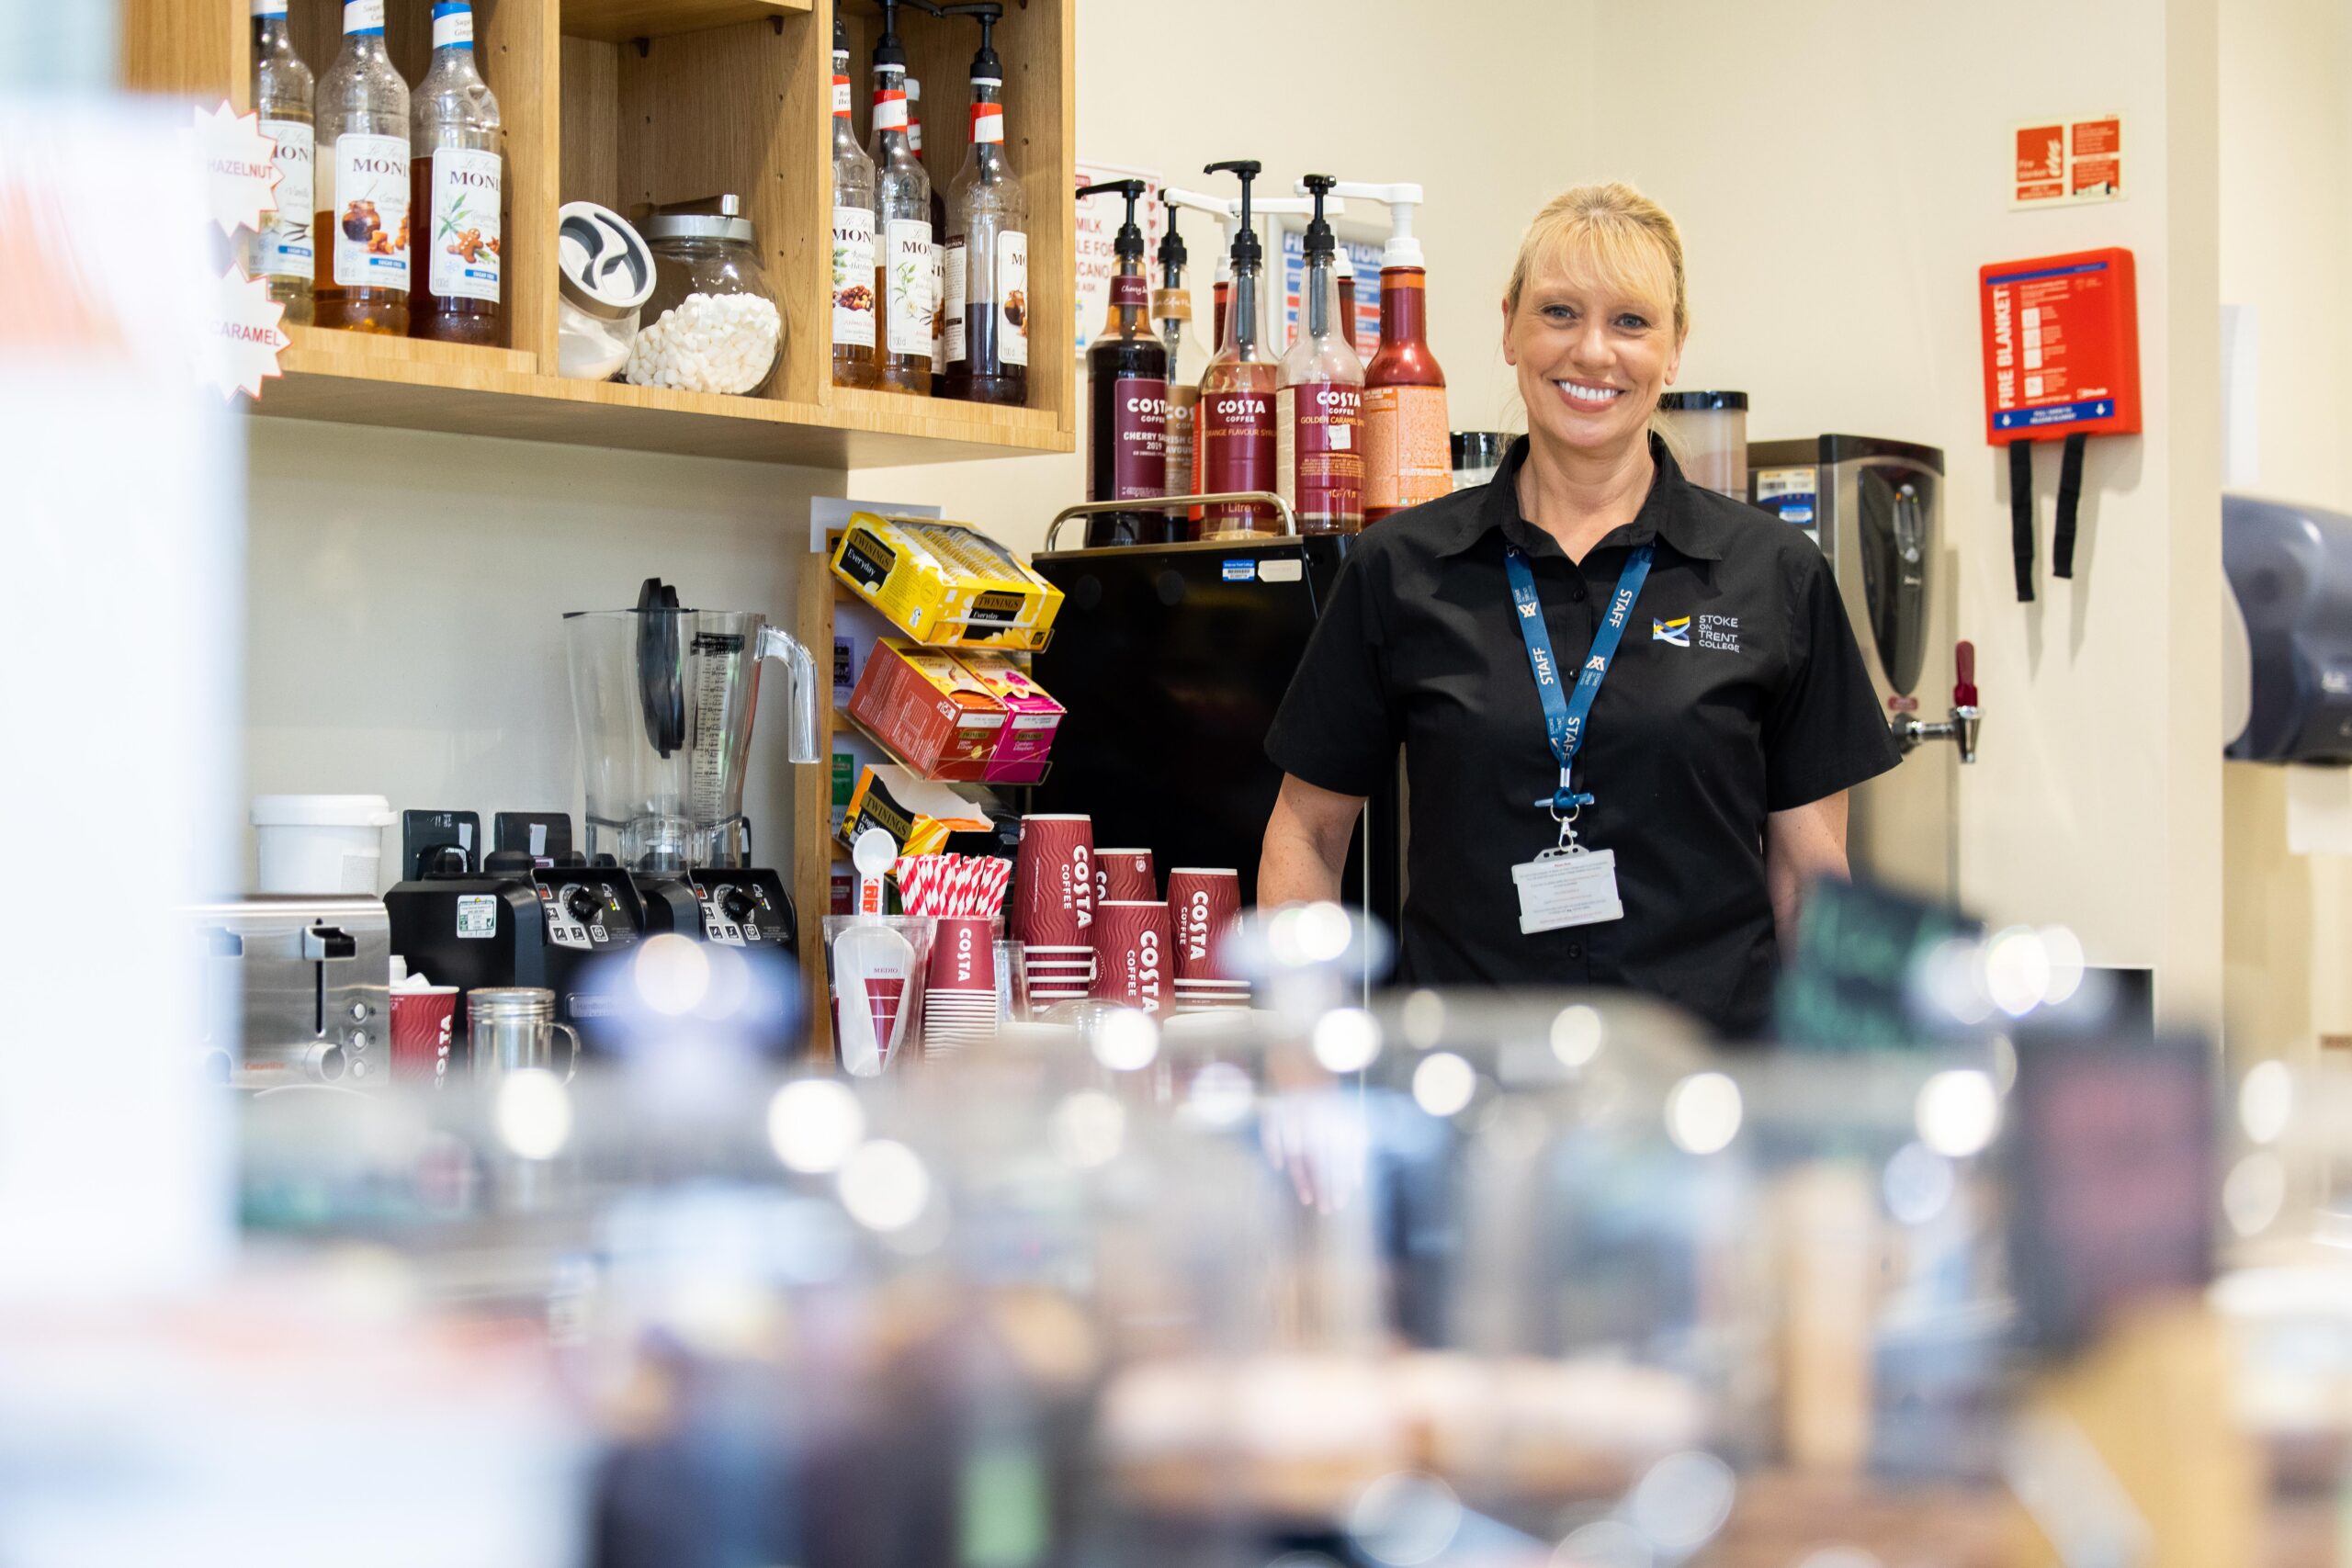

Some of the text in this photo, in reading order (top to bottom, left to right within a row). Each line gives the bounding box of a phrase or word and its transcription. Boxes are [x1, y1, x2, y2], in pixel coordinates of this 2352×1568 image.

[207, 159, 273, 179] HAZELNUT
[1216, 399, 1266, 415] COSTA
[1316, 390, 1361, 408] COSTA
[1225, 415, 1256, 423] COFFEE
[1300, 415, 1329, 425] GOLDEN
[1329, 416, 1357, 426] CARAMEL
[1329, 407, 1354, 416] COFFEE
[1123, 432, 1157, 442] CHERRY
[1227, 427, 1260, 437] FLAVOUR
[1228, 502, 1251, 513] Litre
[854, 535, 890, 568] TWININGS
[847, 547, 876, 578] Everyday
[978, 596, 1020, 608] TWININGS
[1609, 588, 1633, 629] STAFF
[972, 611, 1000, 620] Everyday
[1699, 614, 1739, 628] STOKE
[1698, 628, 1738, 644] TRENT
[1699, 623, 1713, 631] ON
[1698, 639, 1740, 654] COLLEGE
[1532, 646, 1554, 686] STAFF
[1563, 716, 1581, 761] STAFF
[865, 795, 907, 836] TWININGS
[1061, 863, 1072, 910] COFFEE
[1073, 844, 1092, 930] COSTA
[1179, 906, 1188, 945] COFFEE
[1189, 890, 1209, 961] COSTA
[956, 927, 973, 983] COSTA
[1126, 949, 1136, 998] COFFEE
[1138, 930, 1159, 1015] COSTA
[434, 1013, 452, 1091] COSTA
